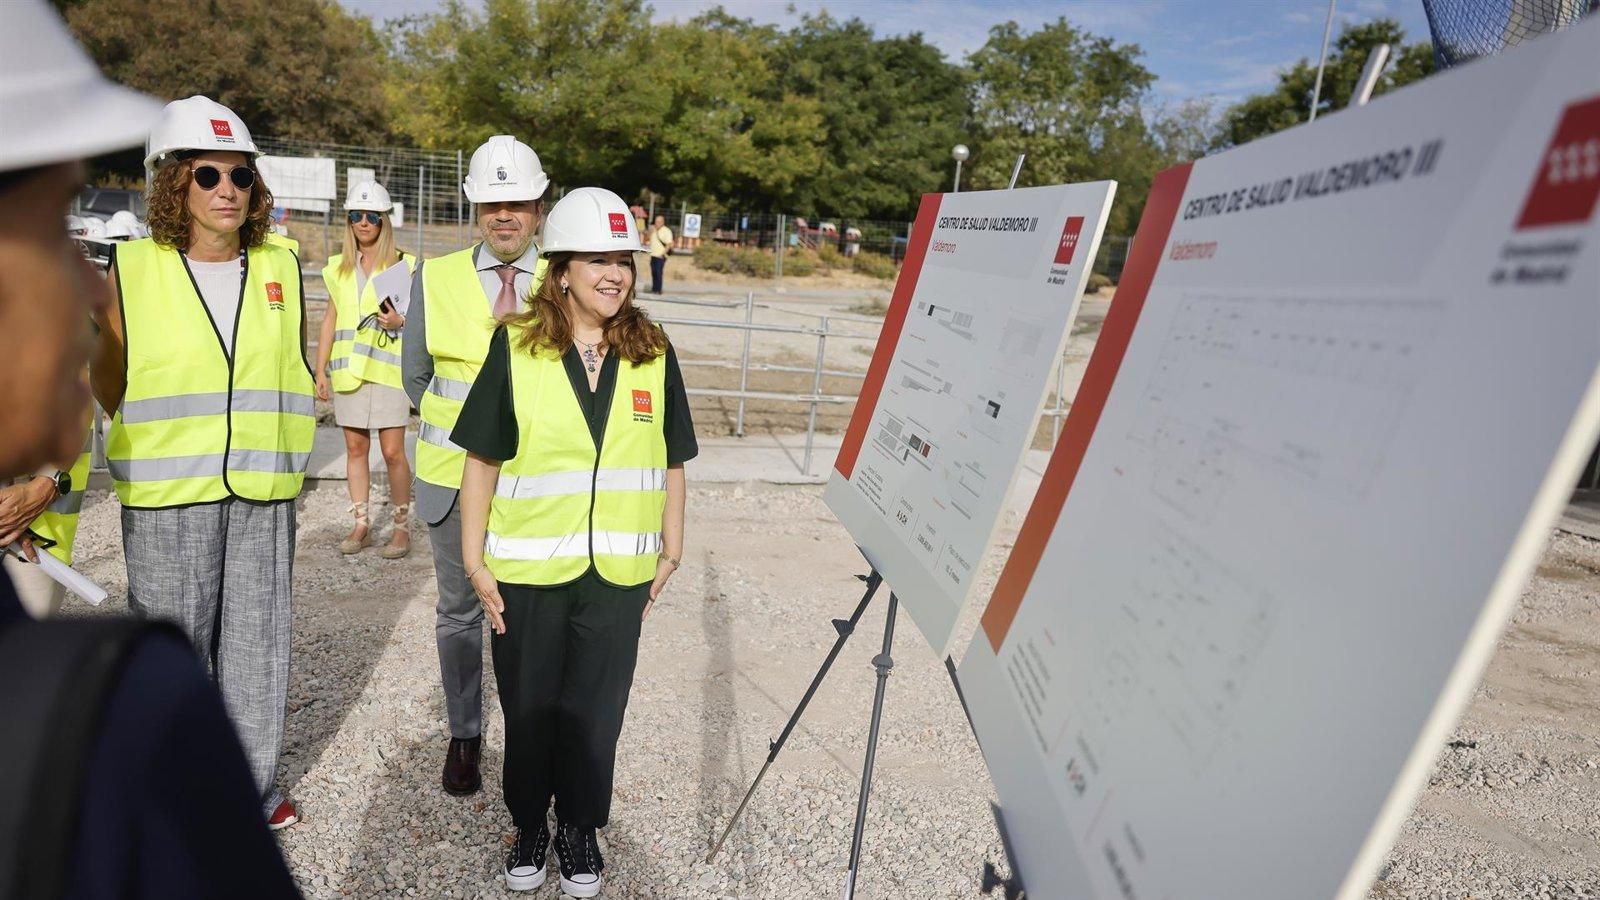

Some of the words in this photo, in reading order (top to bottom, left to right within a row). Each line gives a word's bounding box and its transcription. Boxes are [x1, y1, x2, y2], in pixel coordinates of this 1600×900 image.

[1183, 192, 1228, 221] CENTRO
[1225, 187, 1248, 214] DE
[1244, 177, 1294, 211] SALUD
[1293, 147, 1412, 199] VALDEMORO
[1412, 136, 1444, 177] III
[938, 216, 961, 230] CENTRO
[959, 217, 970, 231] DE
[968, 217, 989, 231] SALUD
[988, 216, 1030, 233] VALDEMORO
[1028, 217, 1039, 233] III
[931, 240, 957, 254] Valdemoro
[1168, 239, 1219, 261] Valdemoro
